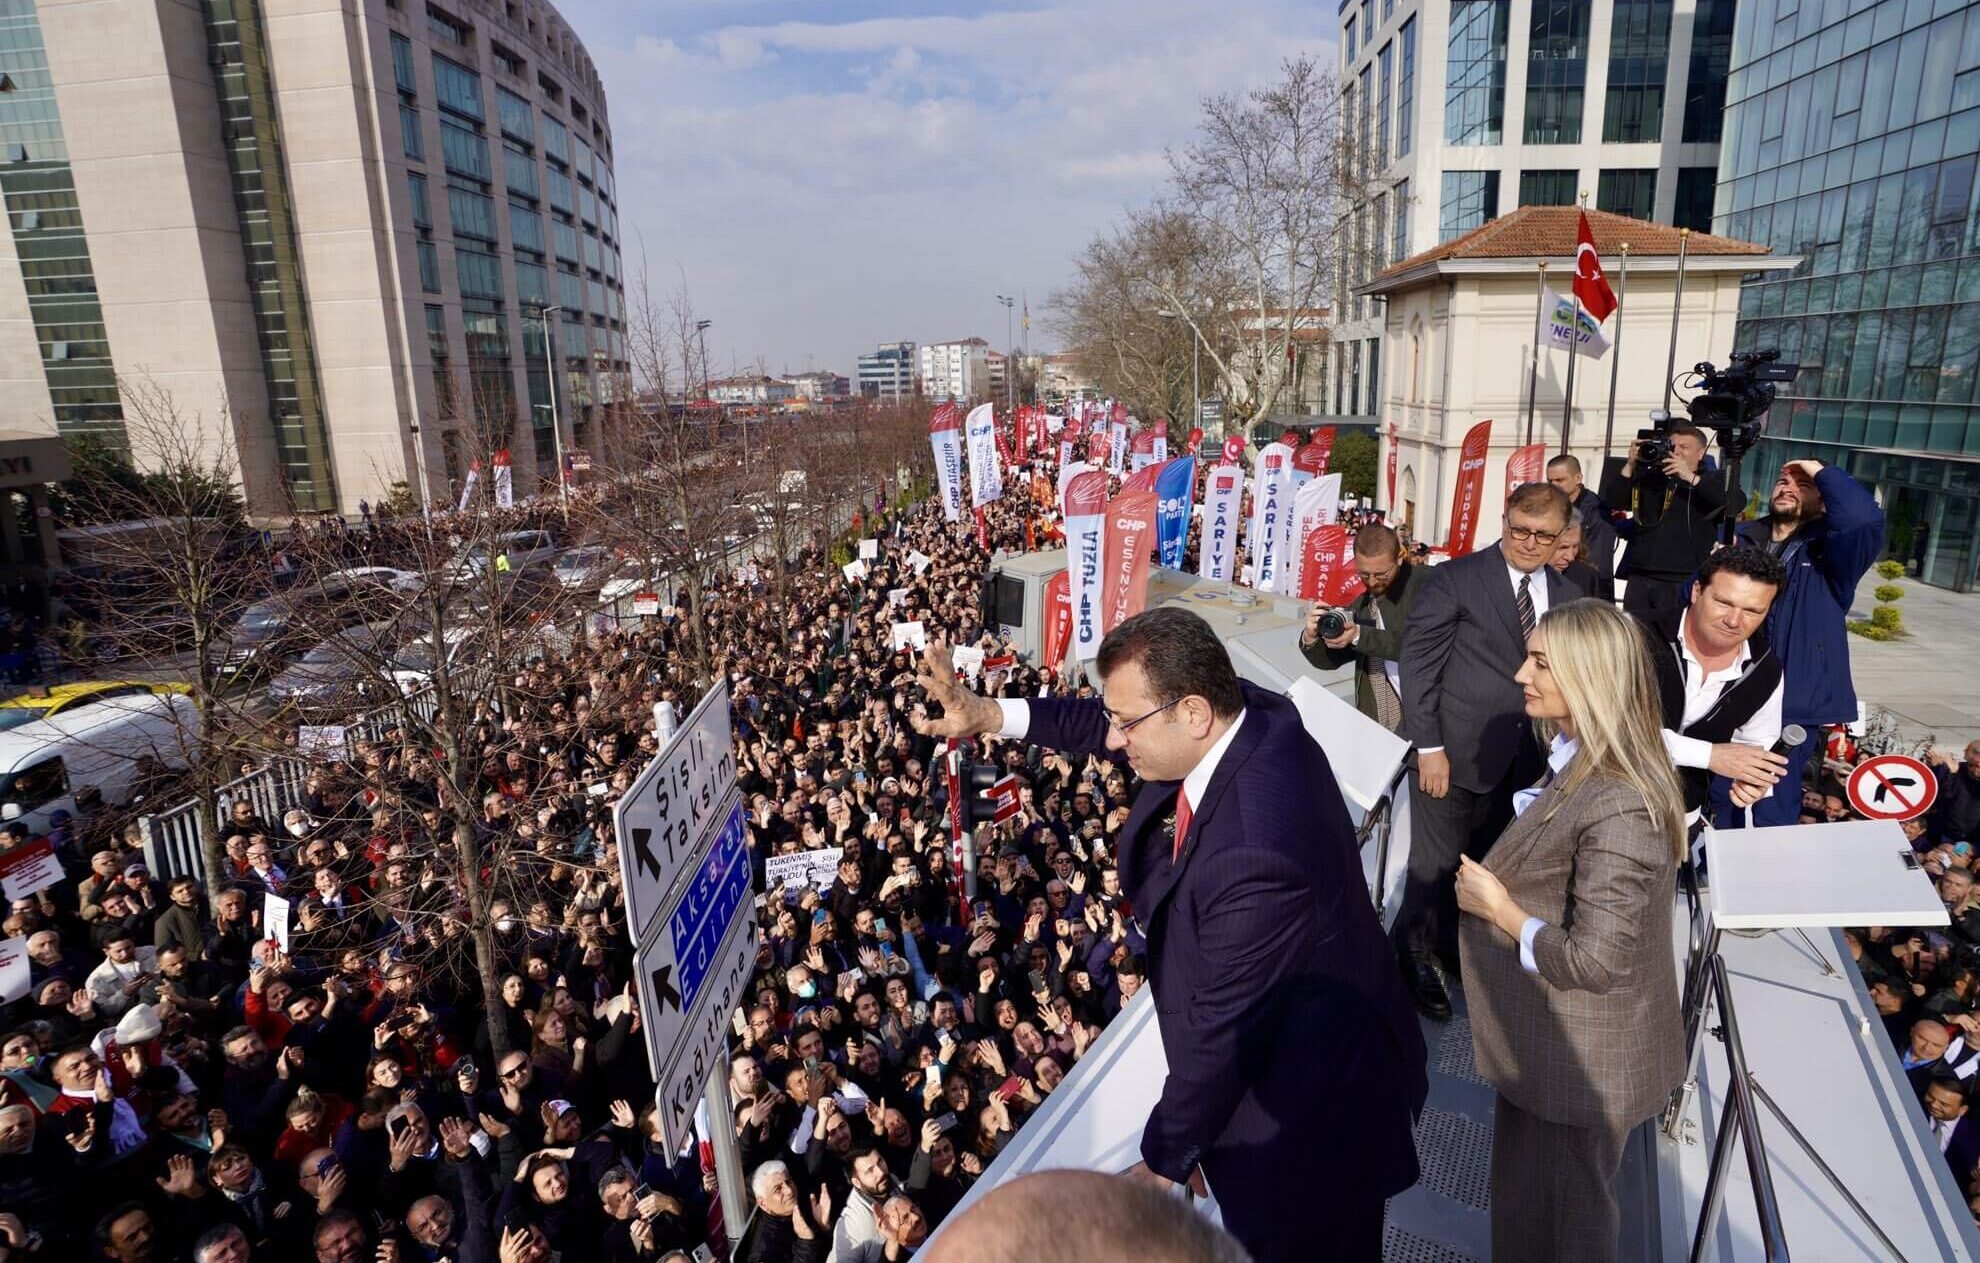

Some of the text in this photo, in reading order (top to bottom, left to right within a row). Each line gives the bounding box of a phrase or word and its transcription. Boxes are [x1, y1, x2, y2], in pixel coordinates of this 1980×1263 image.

[971, 425, 991, 436] CHP
[1463, 458, 1485, 471] CHP
[949, 485, 960, 510] CHP
[1116, 518, 1148, 532] CHP
[1261, 483, 1278, 581] SARIYER
[1211, 502, 1228, 579] SARIYE
[1314, 551, 1337, 563] CHP
[1079, 531, 1098, 643] CHP TUZLA
[655, 730, 706, 822] Şişli
[662, 750, 733, 866] Taksim
[674, 813, 744, 951] Aksaray
[766, 871, 802, 884] UUDU
[681, 860, 751, 1001] Edirne
[671, 951, 746, 1127] Kağıthane
